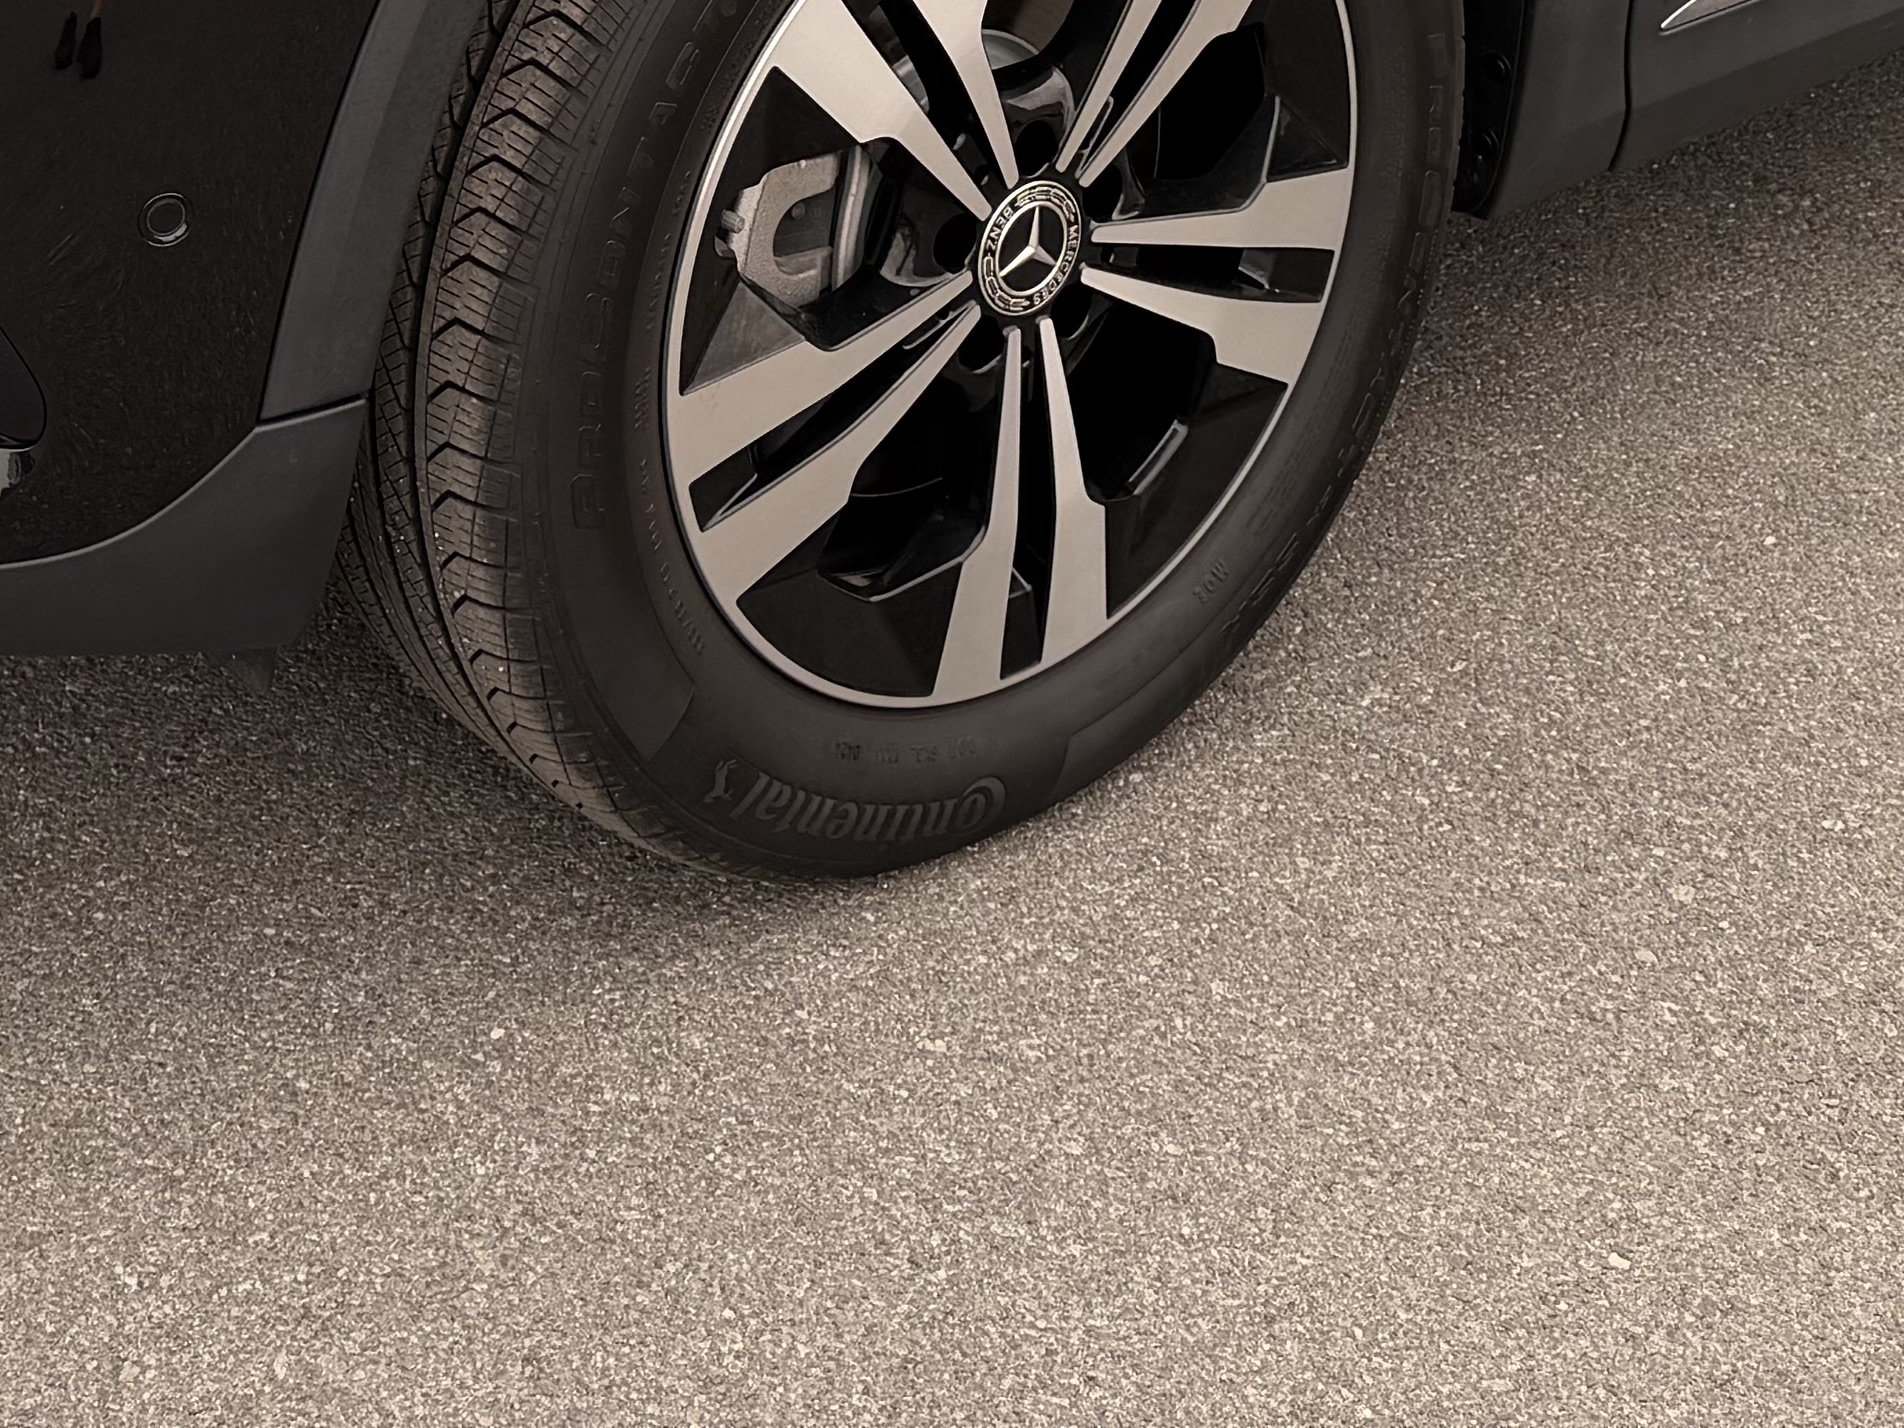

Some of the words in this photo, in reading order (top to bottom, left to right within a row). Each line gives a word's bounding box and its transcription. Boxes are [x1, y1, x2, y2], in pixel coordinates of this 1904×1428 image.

[985, 205, 1015, 251] BENZ
[1032, 223, 1080, 306] MERCEDES
[728, 775, 1007, 842] Continental
